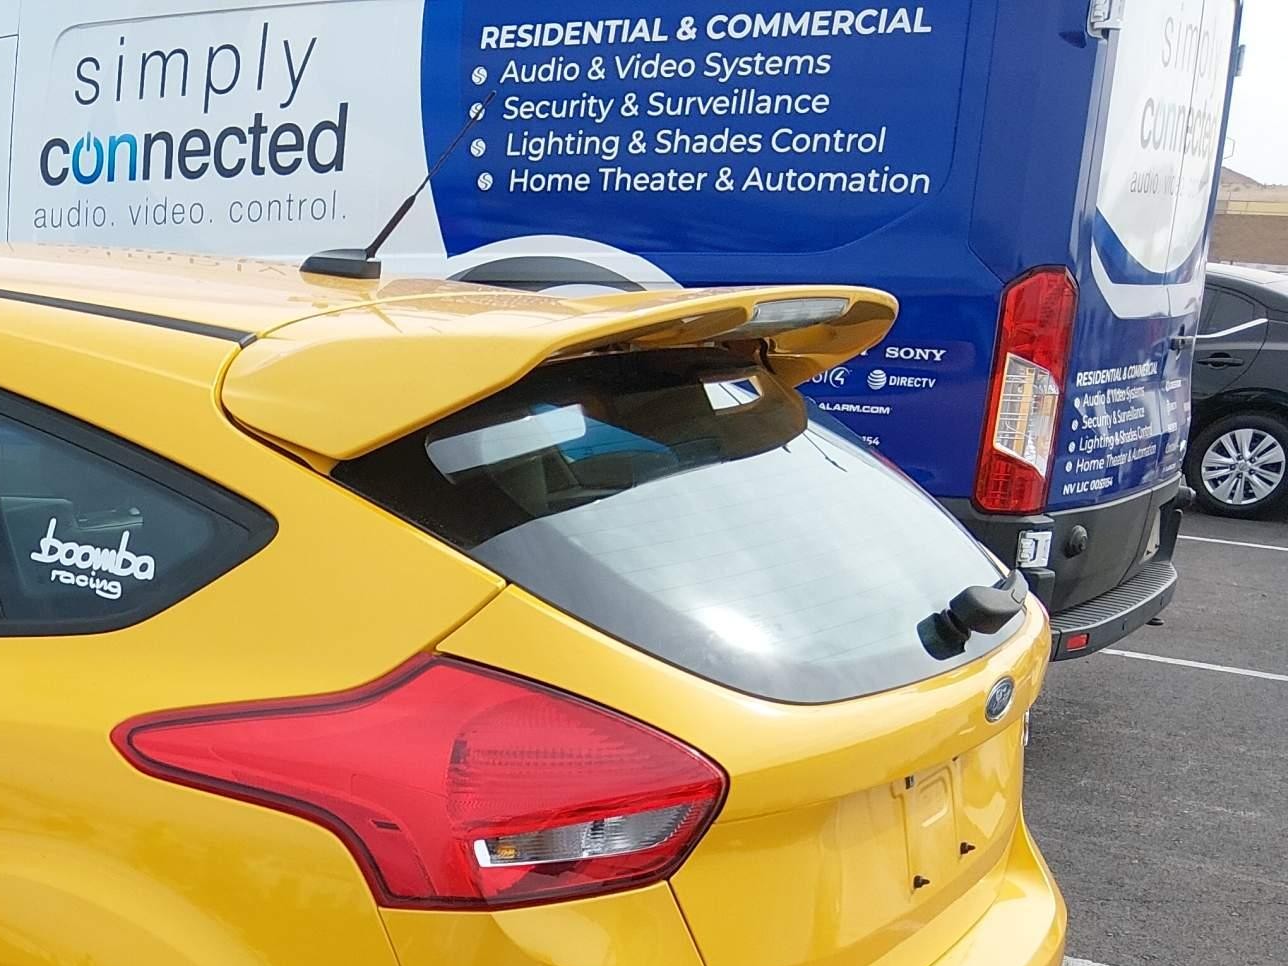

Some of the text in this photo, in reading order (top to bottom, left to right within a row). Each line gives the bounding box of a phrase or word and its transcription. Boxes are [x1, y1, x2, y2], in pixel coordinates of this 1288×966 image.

[479, 7, 933, 49] RESIDENTIAL & COMMERCIAL
[74, 22, 318, 115] simply
[500, 51, 832, 84] Audio & Video Systems
[502, 88, 831, 123] Security & Surveillance
[40, 102, 349, 187] connected
[505, 126, 887, 161] Lighting & Shades Control
[508, 166, 932, 195] Home Theater & Automation
[33, 189, 347, 230] audio. video. control.
[885, 346, 947, 361] SONY
[888, 375, 937, 389] DIRECTV
[1076, 370, 1122, 387] RESIDENTIAL
[818, 402, 891, 415] ALARM.COM
[1083, 393, 1105, 408] Audio
[1111, 389, 1126, 404] Video
[1081, 413, 1112, 430] Security
[1079, 436, 1114, 454] Lighting
[1075, 458, 1105, 474] Home
[1063, 482, 1076, 495] NV
[1076, 481, 1089, 493] LIC
[30, 517, 155, 580] boomba
[49, 569, 122, 600] racing
